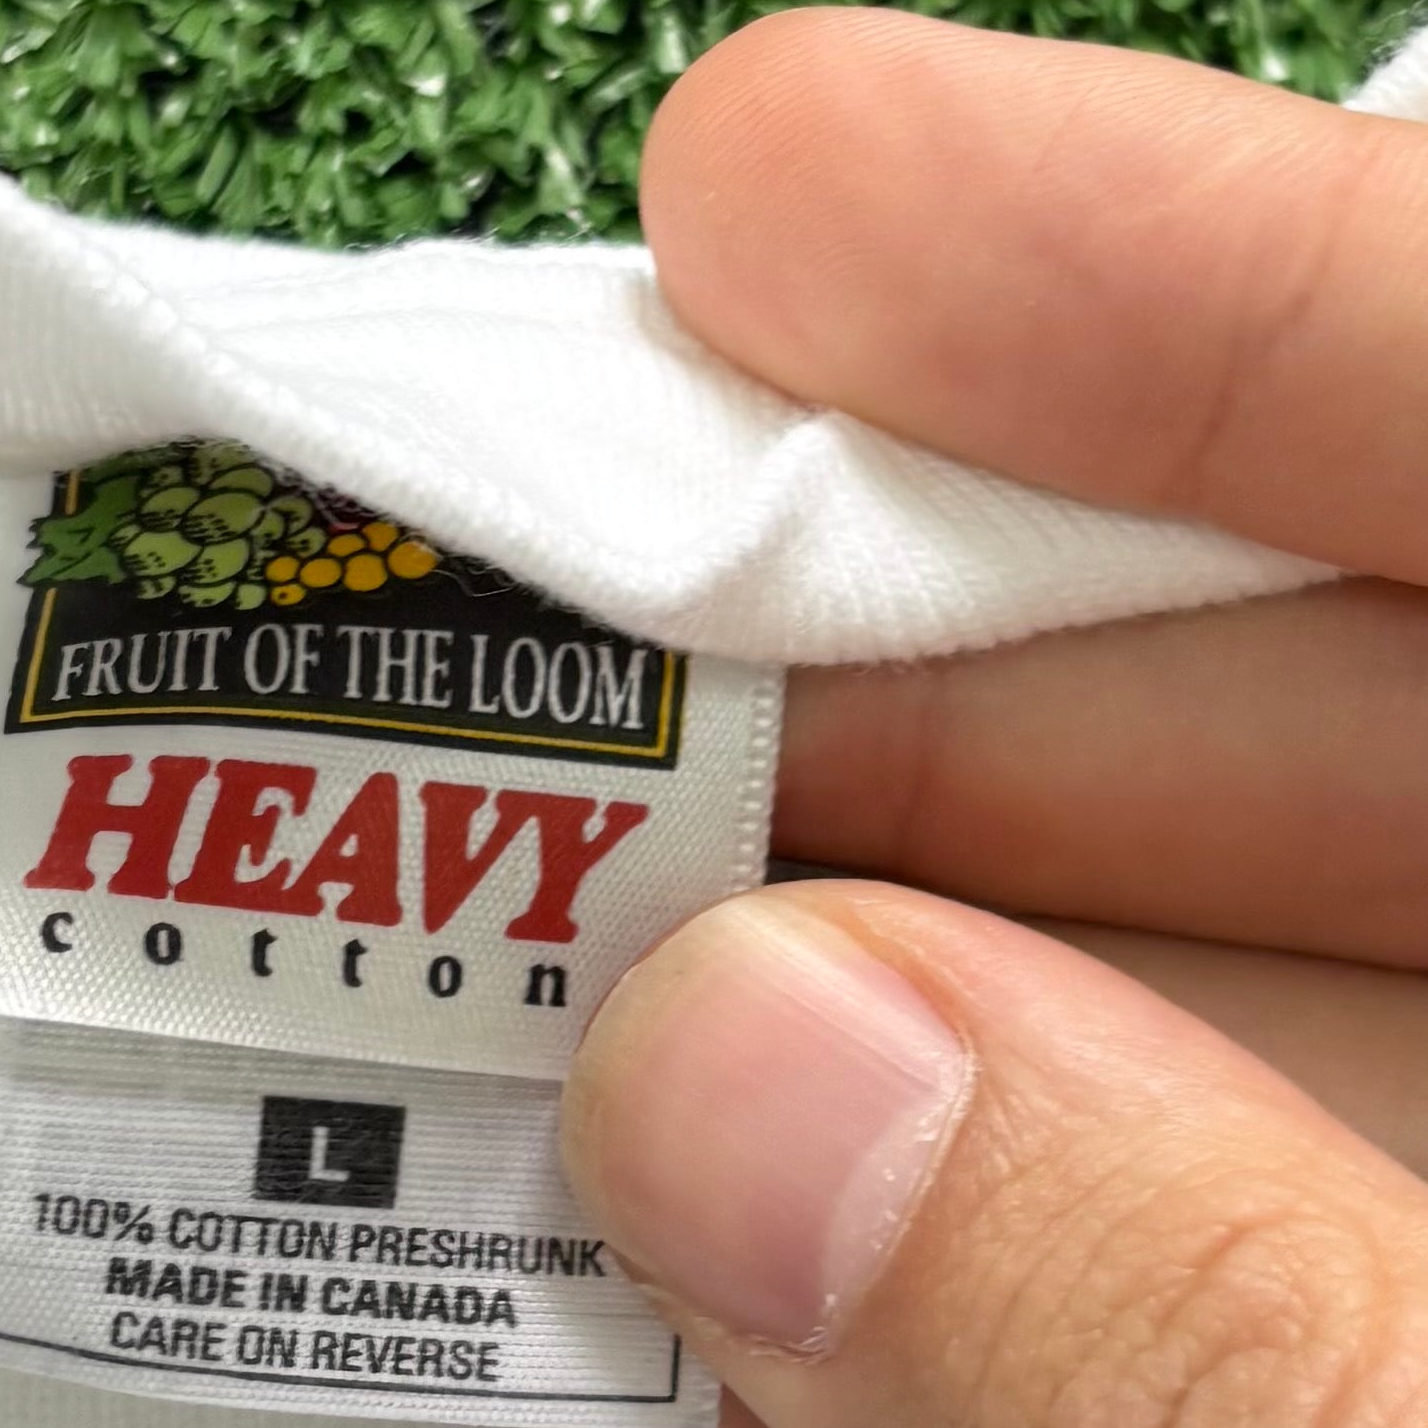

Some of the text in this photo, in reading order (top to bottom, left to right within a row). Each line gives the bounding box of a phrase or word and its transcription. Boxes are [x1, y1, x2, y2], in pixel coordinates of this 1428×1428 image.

[52, 622, 649, 730] FRUIT OF THE LOOM
[24, 754, 649, 944] HEAVY
[41, 911, 567, 1008] cotton
[310, 1125, 348, 1183] L
[33, 1192, 606, 1278] 100% COTTON PRESHRUNK
[106, 1258, 517, 1329] MADE IN CANADA
[109, 1311, 501, 1383] CARE ON REVERSE
